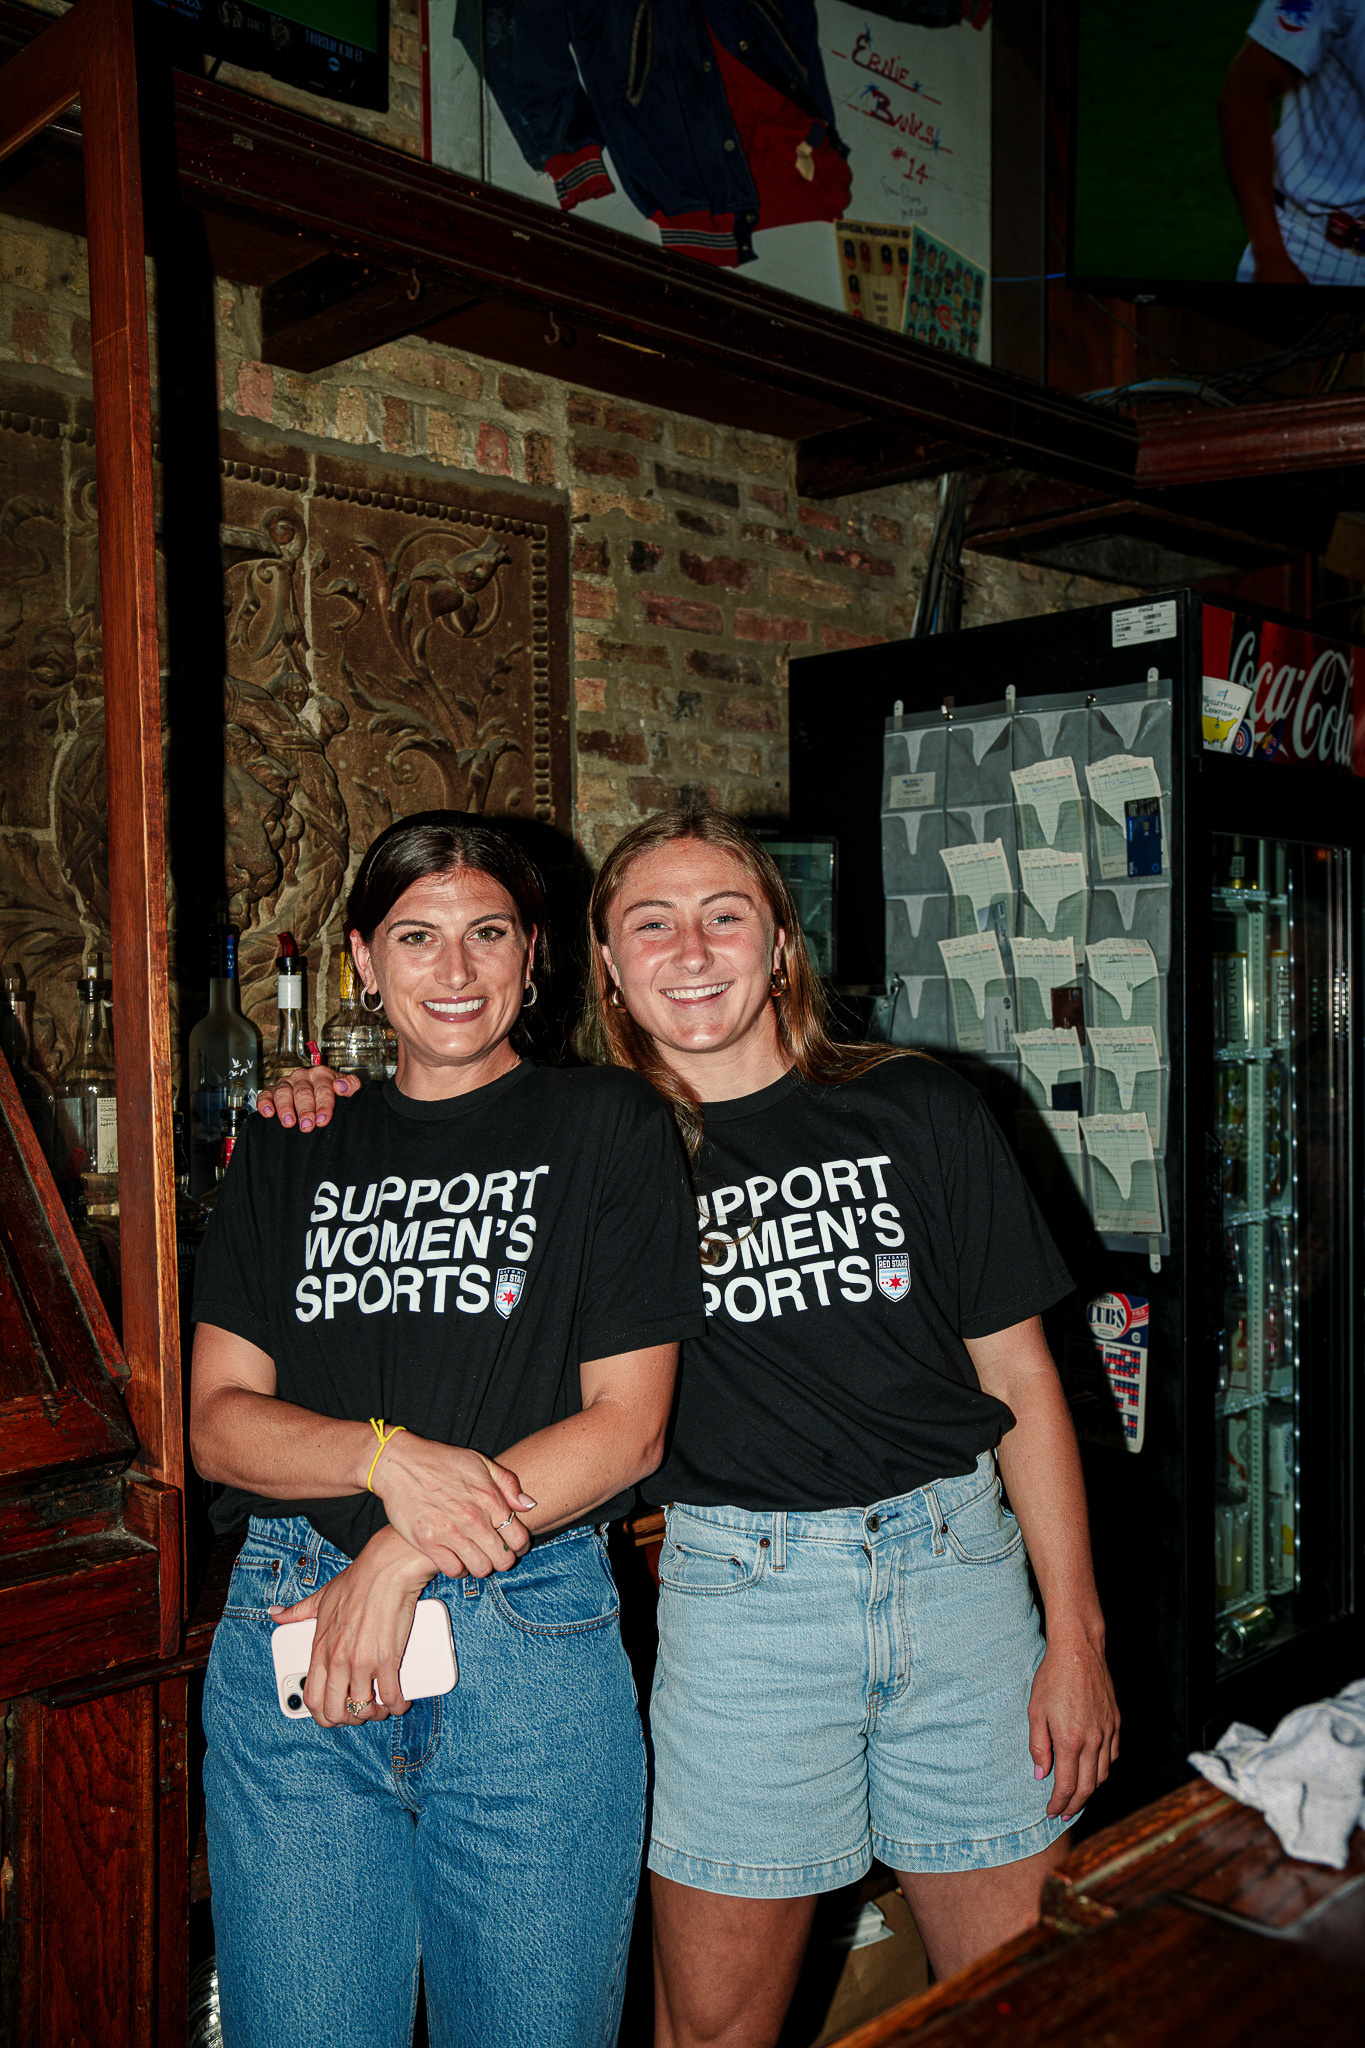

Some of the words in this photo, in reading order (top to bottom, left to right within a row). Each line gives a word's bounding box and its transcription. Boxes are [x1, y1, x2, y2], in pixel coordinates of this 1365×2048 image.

[310, 1165, 550, 1223] SUPPORT
[305, 1214, 537, 1270] WOMEN'S
[699, 1202, 906, 1276] OMEN'S
[878, 1260, 891, 1269] RED
[891, 1259, 908, 1268] STARS
[295, 1264, 491, 1323] SPORTS
[702, 1255, 873, 1323] PORTS
[1087, 1303, 1126, 1329] CUBS
